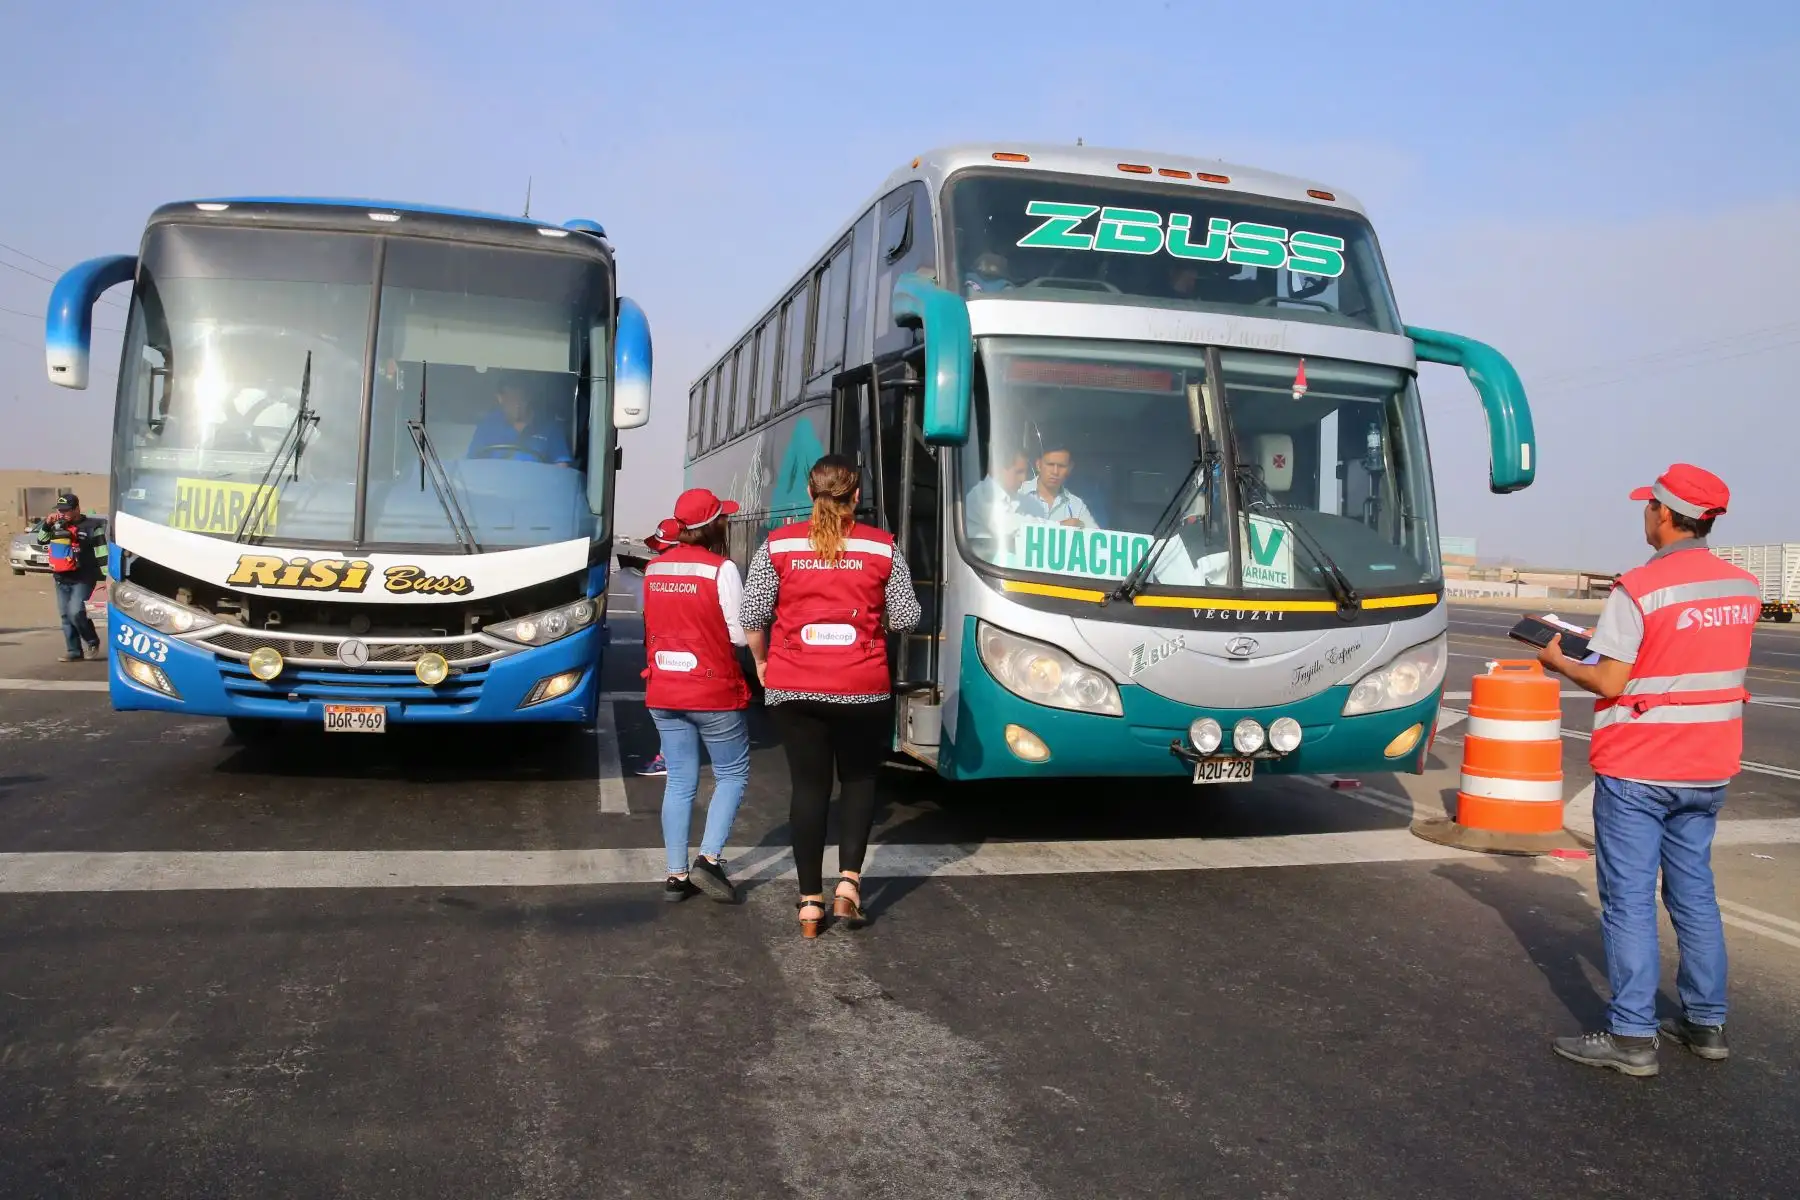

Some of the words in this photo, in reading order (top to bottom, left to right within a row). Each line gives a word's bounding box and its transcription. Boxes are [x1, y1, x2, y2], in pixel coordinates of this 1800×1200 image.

[1016, 200, 1345, 278] ZBUSS
[174, 485, 276, 535] HUARAL
[1024, 525, 1149, 577] HUACHO
[1248, 522, 1285, 567] V
[383, 564, 475, 596] Buss
[791, 558, 863, 570] FISCALIZACION
[1193, 608, 1284, 621] VEGUZTI
[117, 624, 169, 663] 303
[327, 712, 383, 729] D6R-969
[1197, 761, 1252, 781] A2U-728
